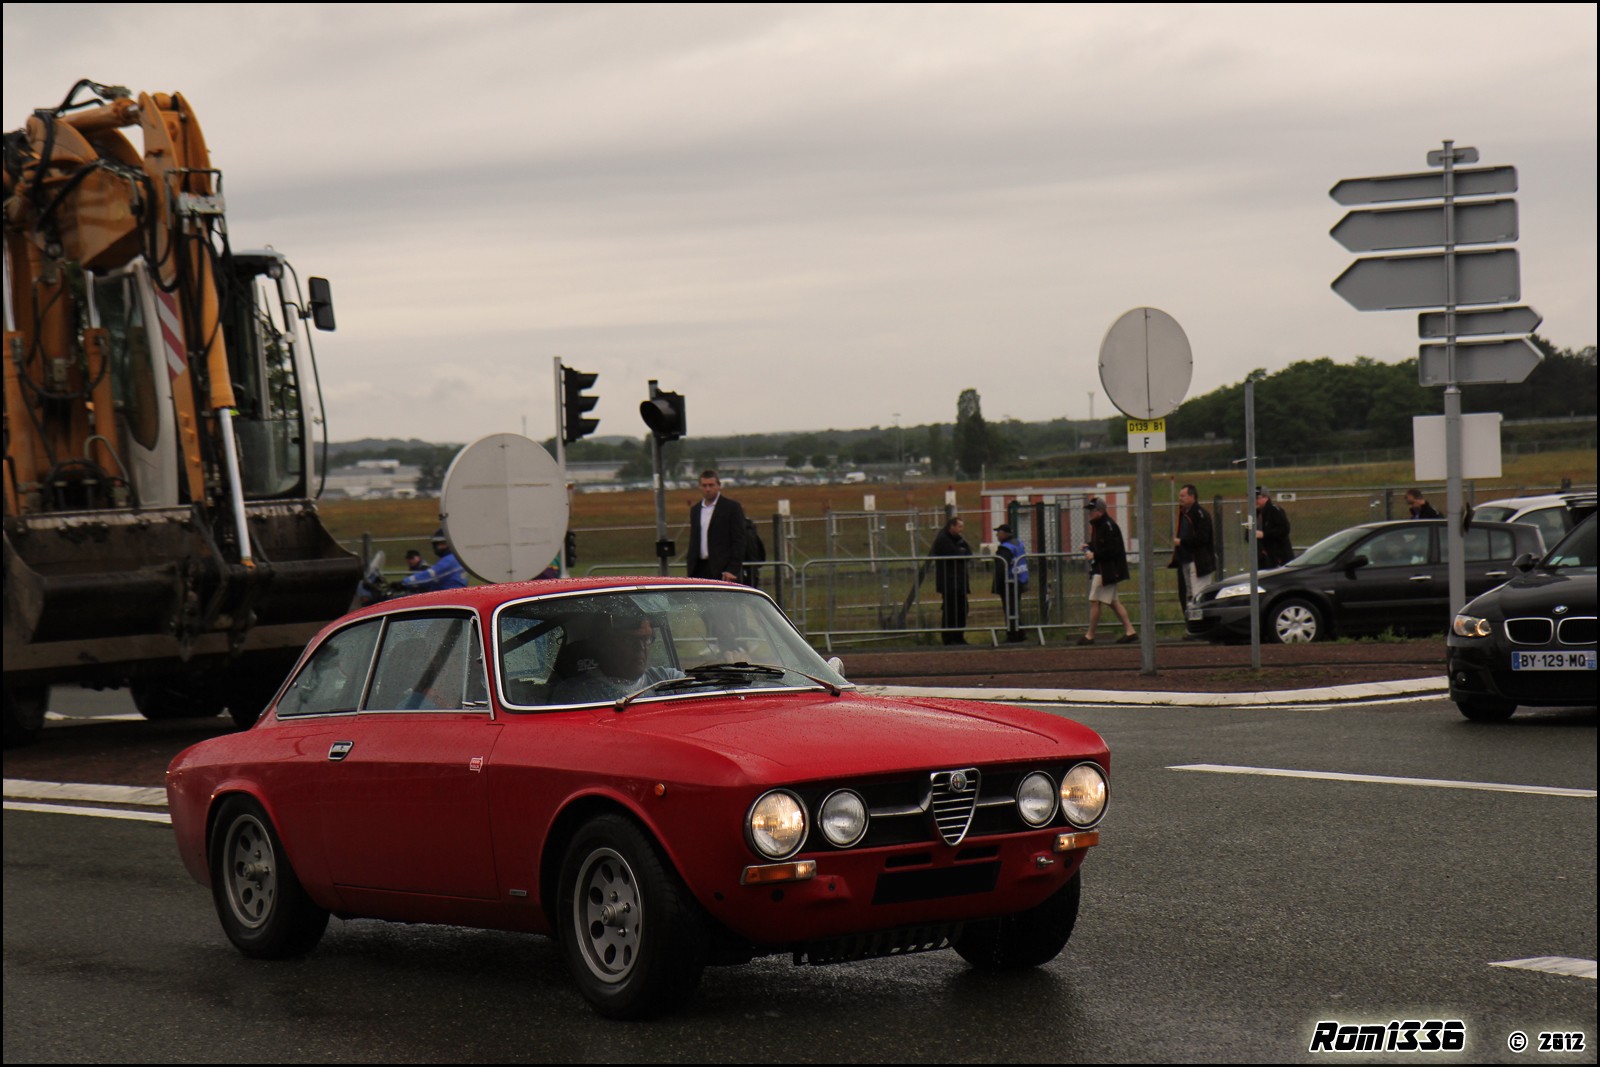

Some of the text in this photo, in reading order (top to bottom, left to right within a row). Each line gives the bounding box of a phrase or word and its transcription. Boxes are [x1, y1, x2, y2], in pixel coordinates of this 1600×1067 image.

[1129, 422, 1149, 432] D139
[1143, 437, 1150, 449] F
[1521, 654, 1587, 668] BY-129-MQ
